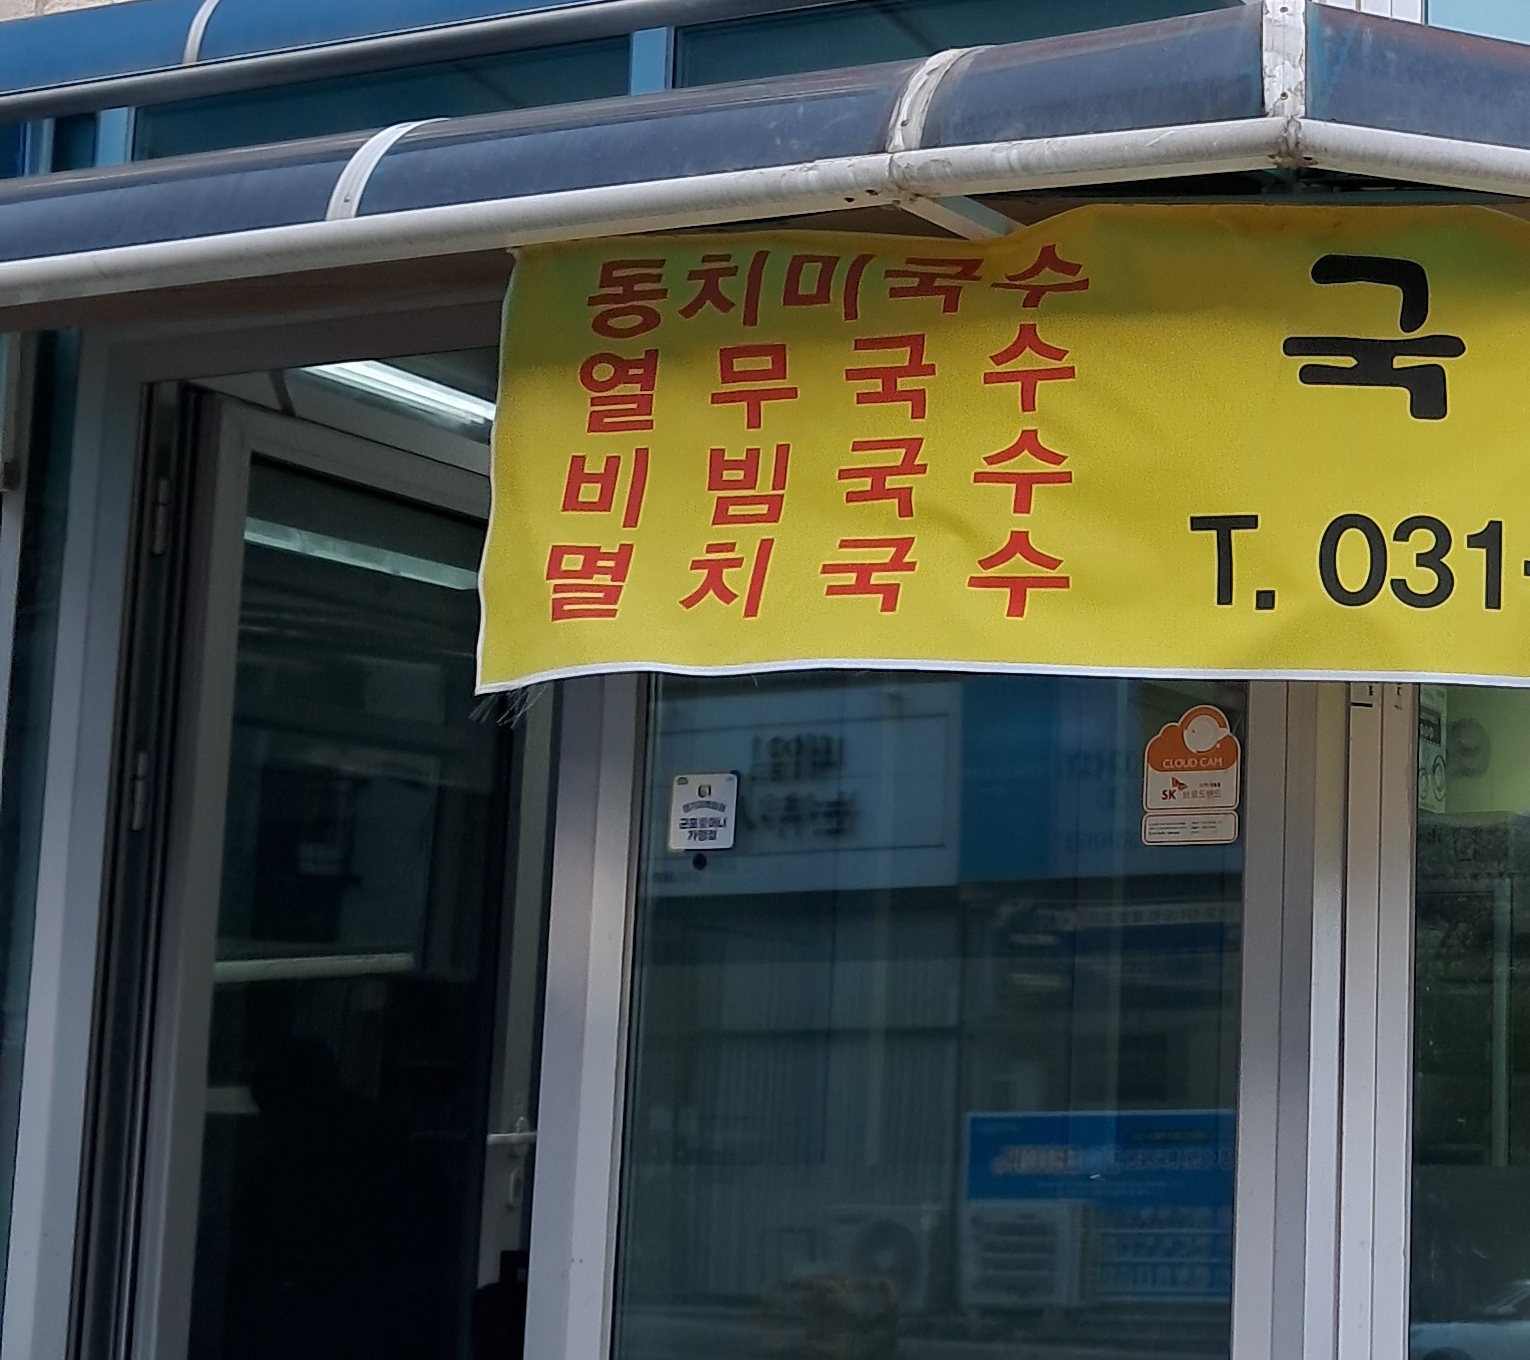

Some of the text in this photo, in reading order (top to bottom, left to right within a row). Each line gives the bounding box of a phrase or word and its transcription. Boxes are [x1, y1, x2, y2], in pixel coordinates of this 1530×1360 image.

[587, 243, 1091, 339] 동치미국수
[1189, 514, 1275, 611] T.
[1162, 757, 1223, 769] CLOUD CAM
[1161, 789, 1177, 800] SK
